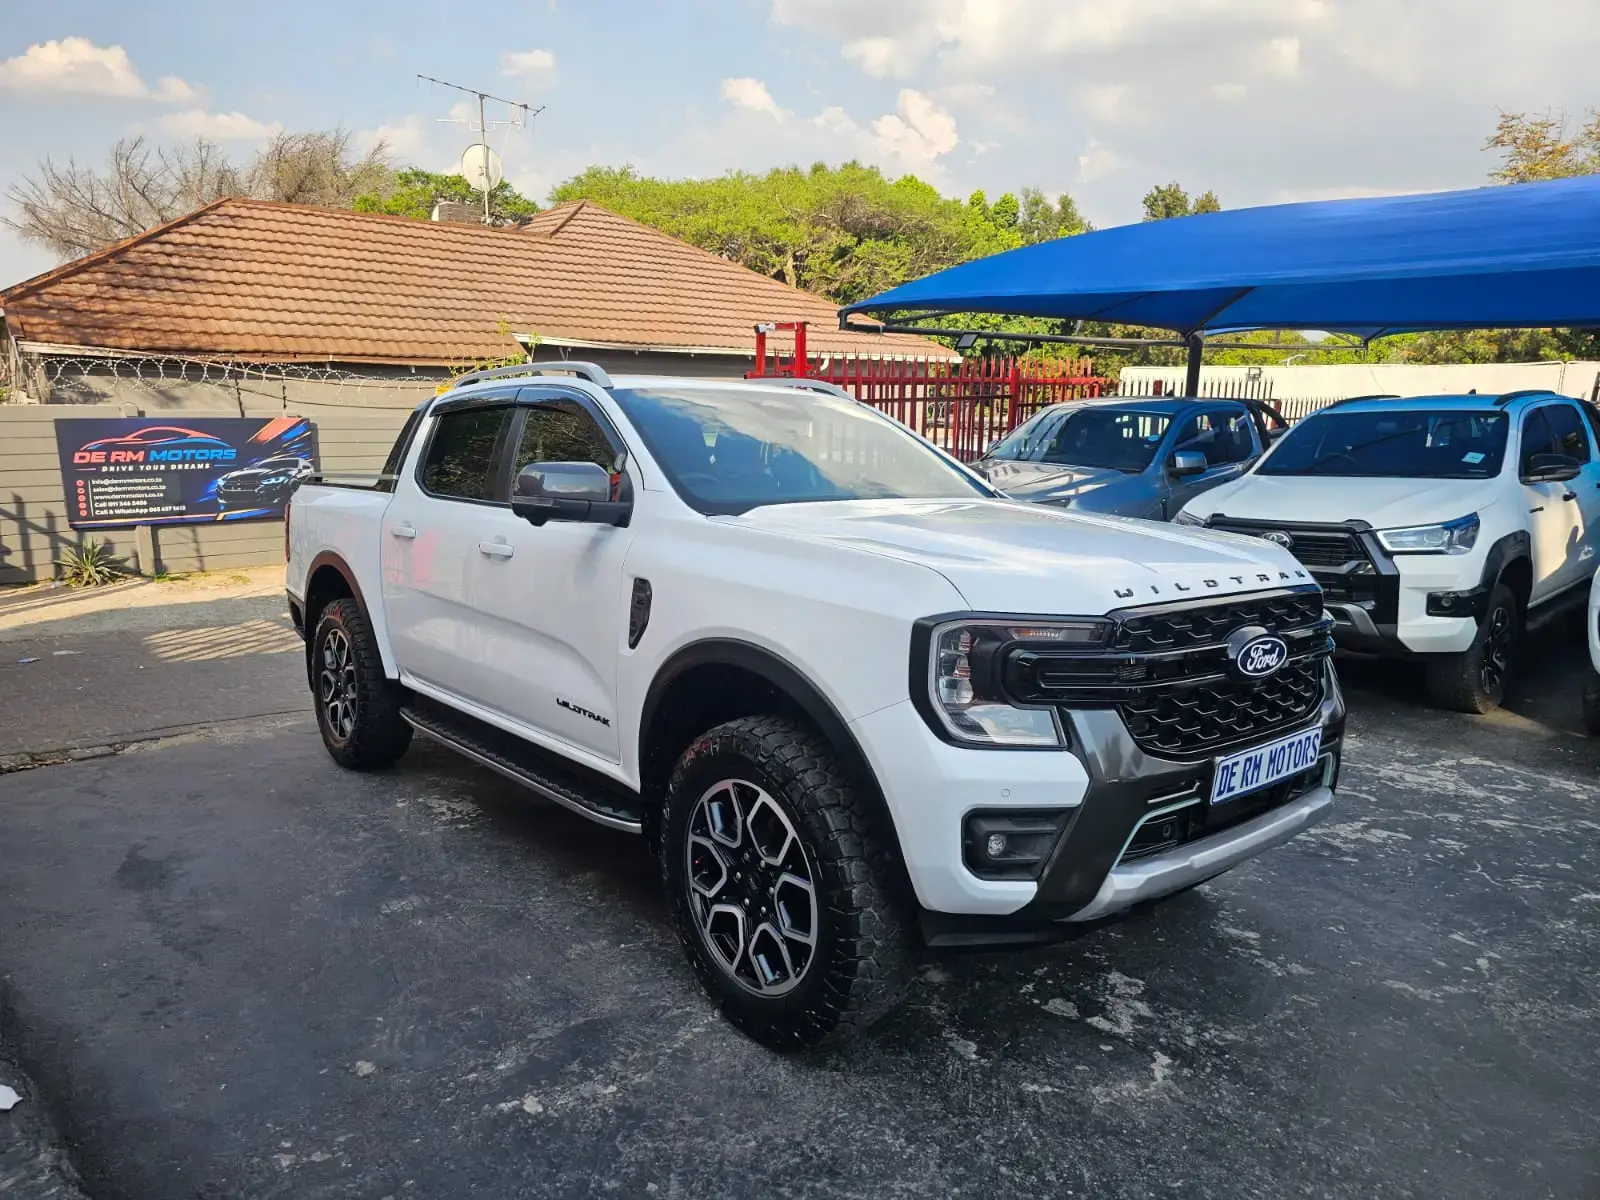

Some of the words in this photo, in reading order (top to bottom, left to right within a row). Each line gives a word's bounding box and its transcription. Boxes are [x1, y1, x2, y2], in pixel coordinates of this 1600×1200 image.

[73, 451, 106, 463] DE
[110, 450, 145, 463] RM
[149, 449, 237, 461] MOTORS
[101, 464, 134, 473] DRIVE
[139, 464, 166, 472] YOUR
[170, 462, 211, 471] DREAMS
[114, 507, 149, 515] WhatsApp
[1114, 570, 1306, 599] WILDTRAK
[1246, 644, 1280, 672] Ford
[556, 697, 611, 729] WILDTRAK
[1215, 760, 1240, 797] DE
[1240, 753, 1262, 790] RM
[1265, 732, 1320, 782] MOTORS
